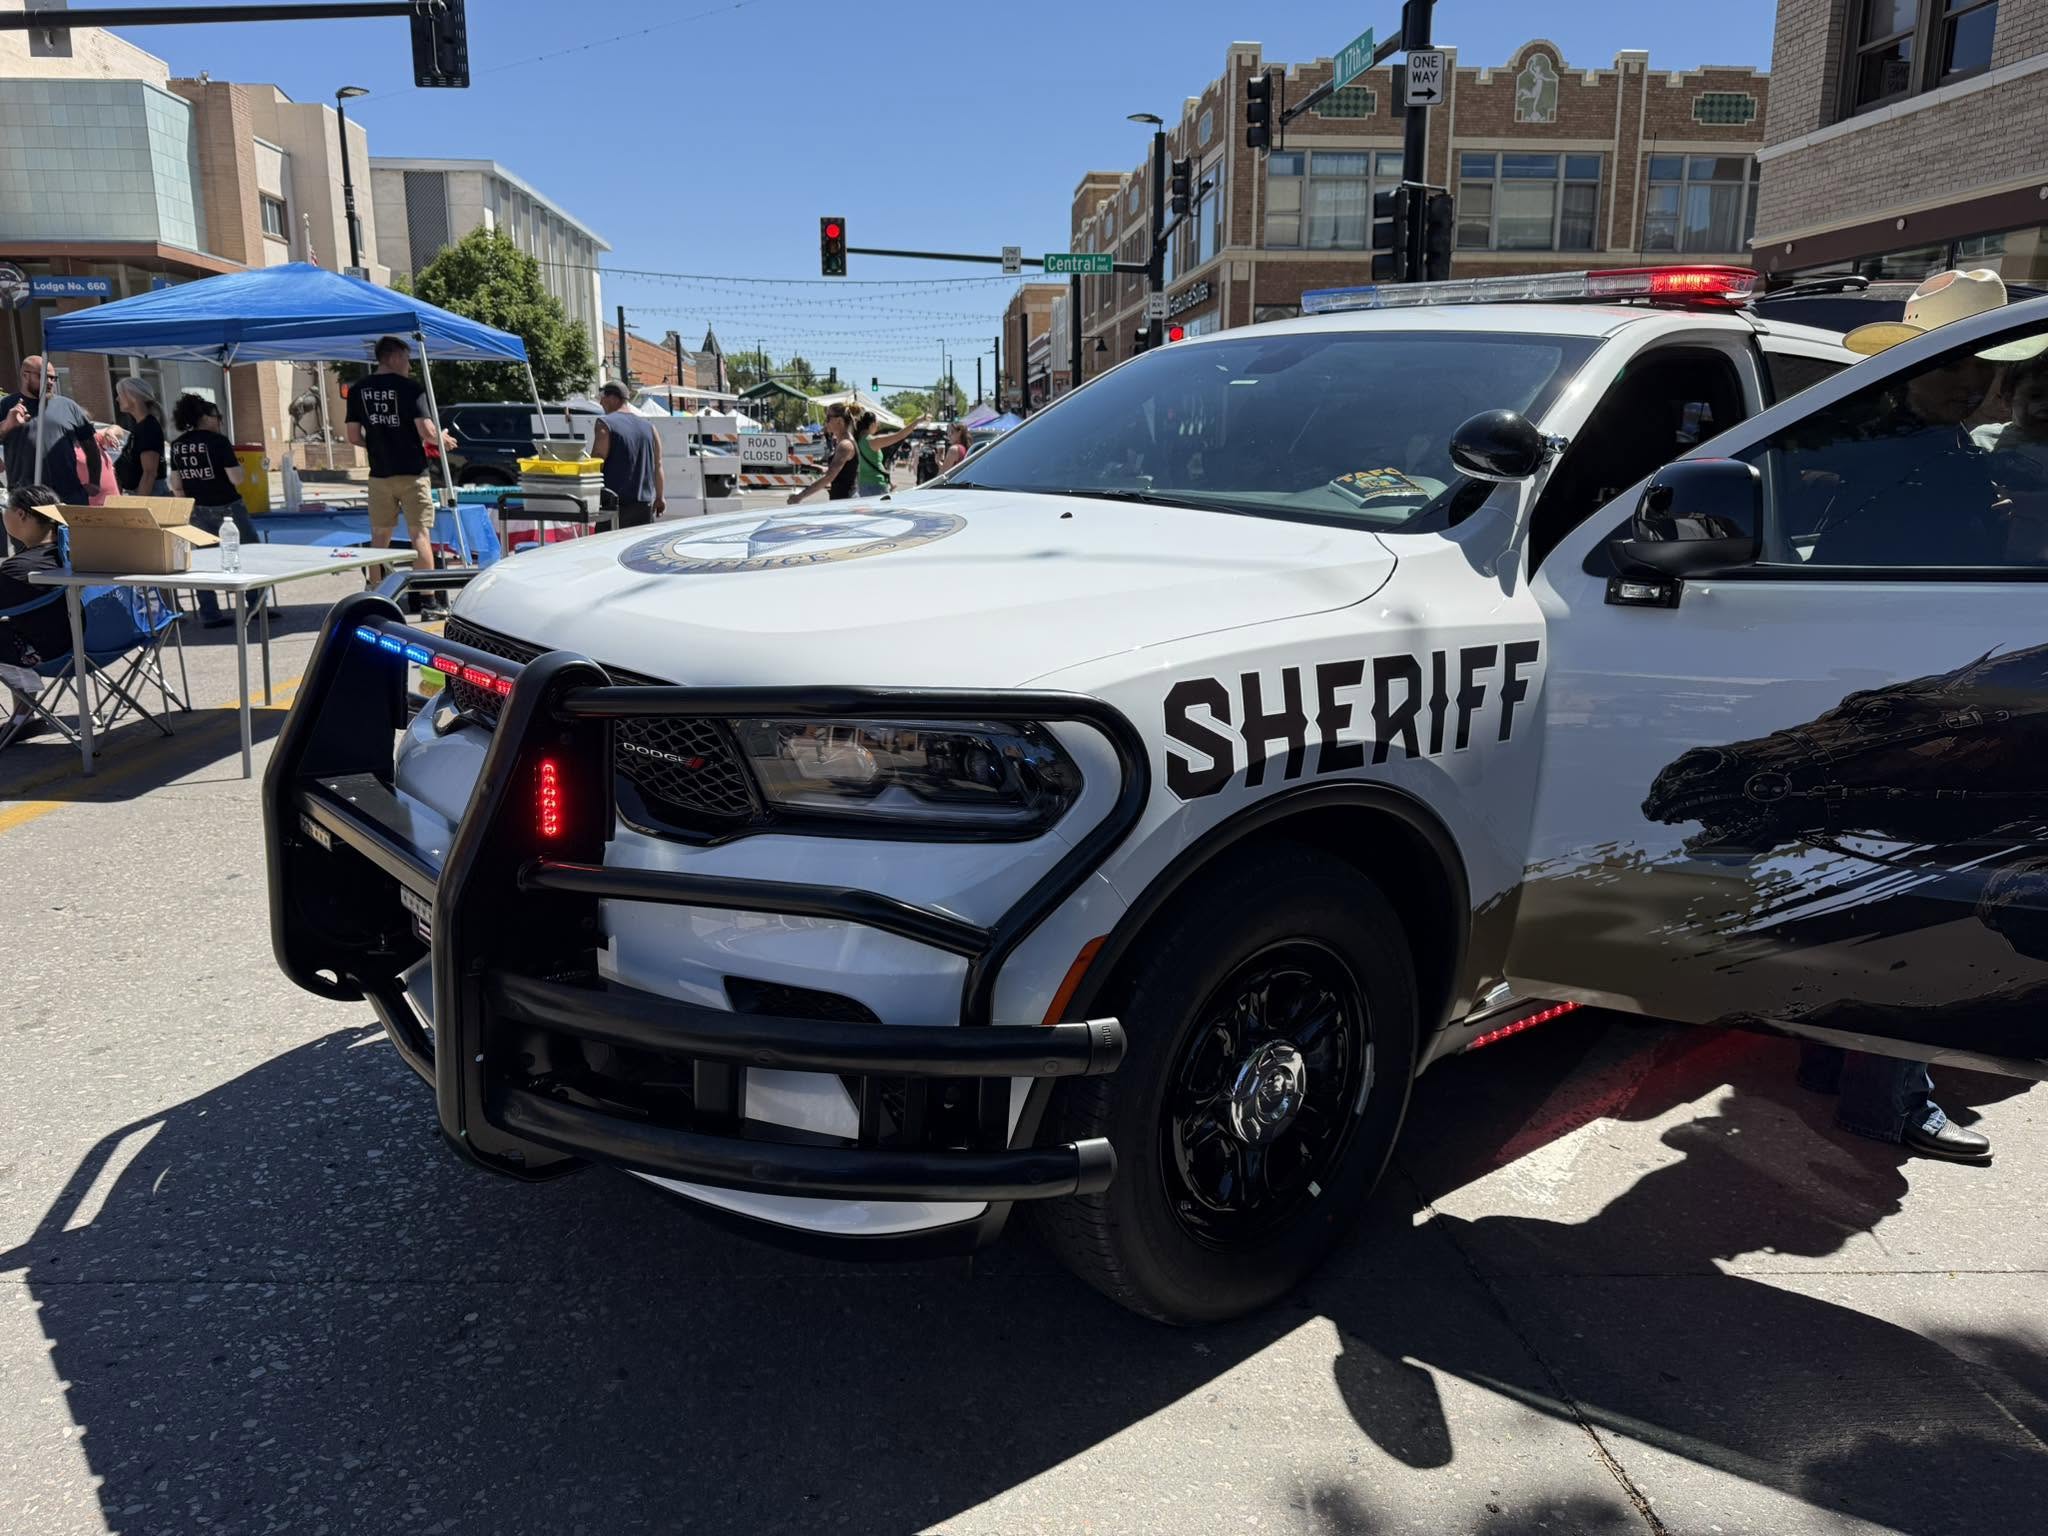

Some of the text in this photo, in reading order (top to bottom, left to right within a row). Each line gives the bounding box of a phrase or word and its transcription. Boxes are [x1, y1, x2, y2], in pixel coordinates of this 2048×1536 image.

[1344, 44, 1362, 78] 17th
[1412, 55, 1438, 69] ONE
[1411, 70, 1439, 84] WAY
[1047, 255, 1096, 272] Central
[33, 281, 107, 292] Lodge No. 660
[363, 389, 396, 401] HERE
[374, 402, 389, 413] TO
[369, 413, 398, 425] SERVE
[172, 442, 206, 455] HERE
[747, 437, 777, 448] ROAD
[181, 455, 199, 467] TO
[743, 450, 783, 462] CLOSED
[180, 466, 212, 480] SERVE
[1163, 640, 1540, 801] SHERIFF
